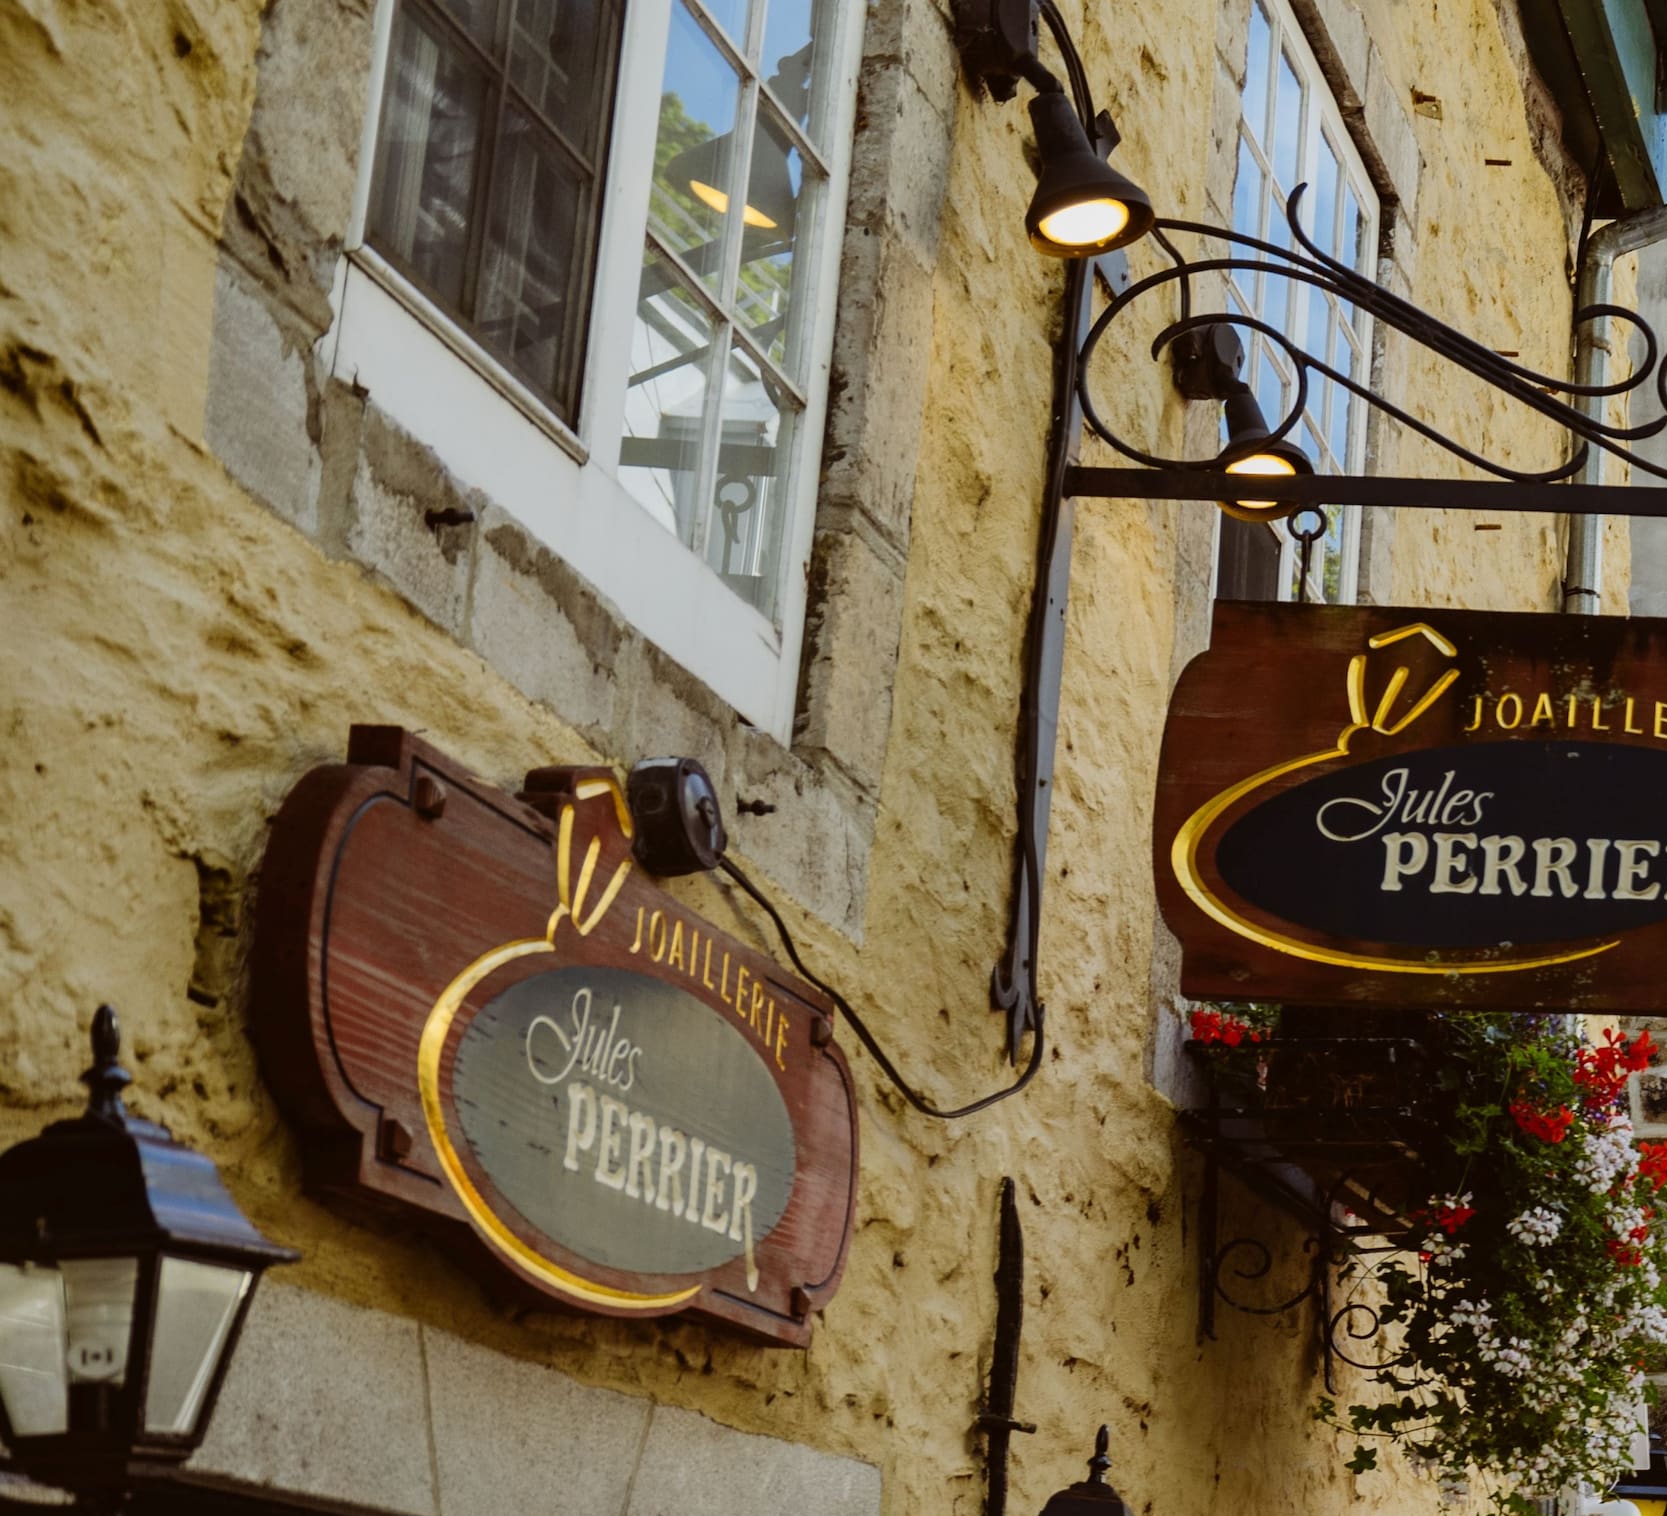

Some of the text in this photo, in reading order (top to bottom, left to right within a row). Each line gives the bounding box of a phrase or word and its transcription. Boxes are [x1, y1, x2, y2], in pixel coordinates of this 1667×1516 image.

[1315, 766, 1495, 843] Jules
[525, 987, 645, 1093] Jules
[629, 904, 793, 1075] JOAILLERIE
[562, 1080, 760, 1293] PERRIER
